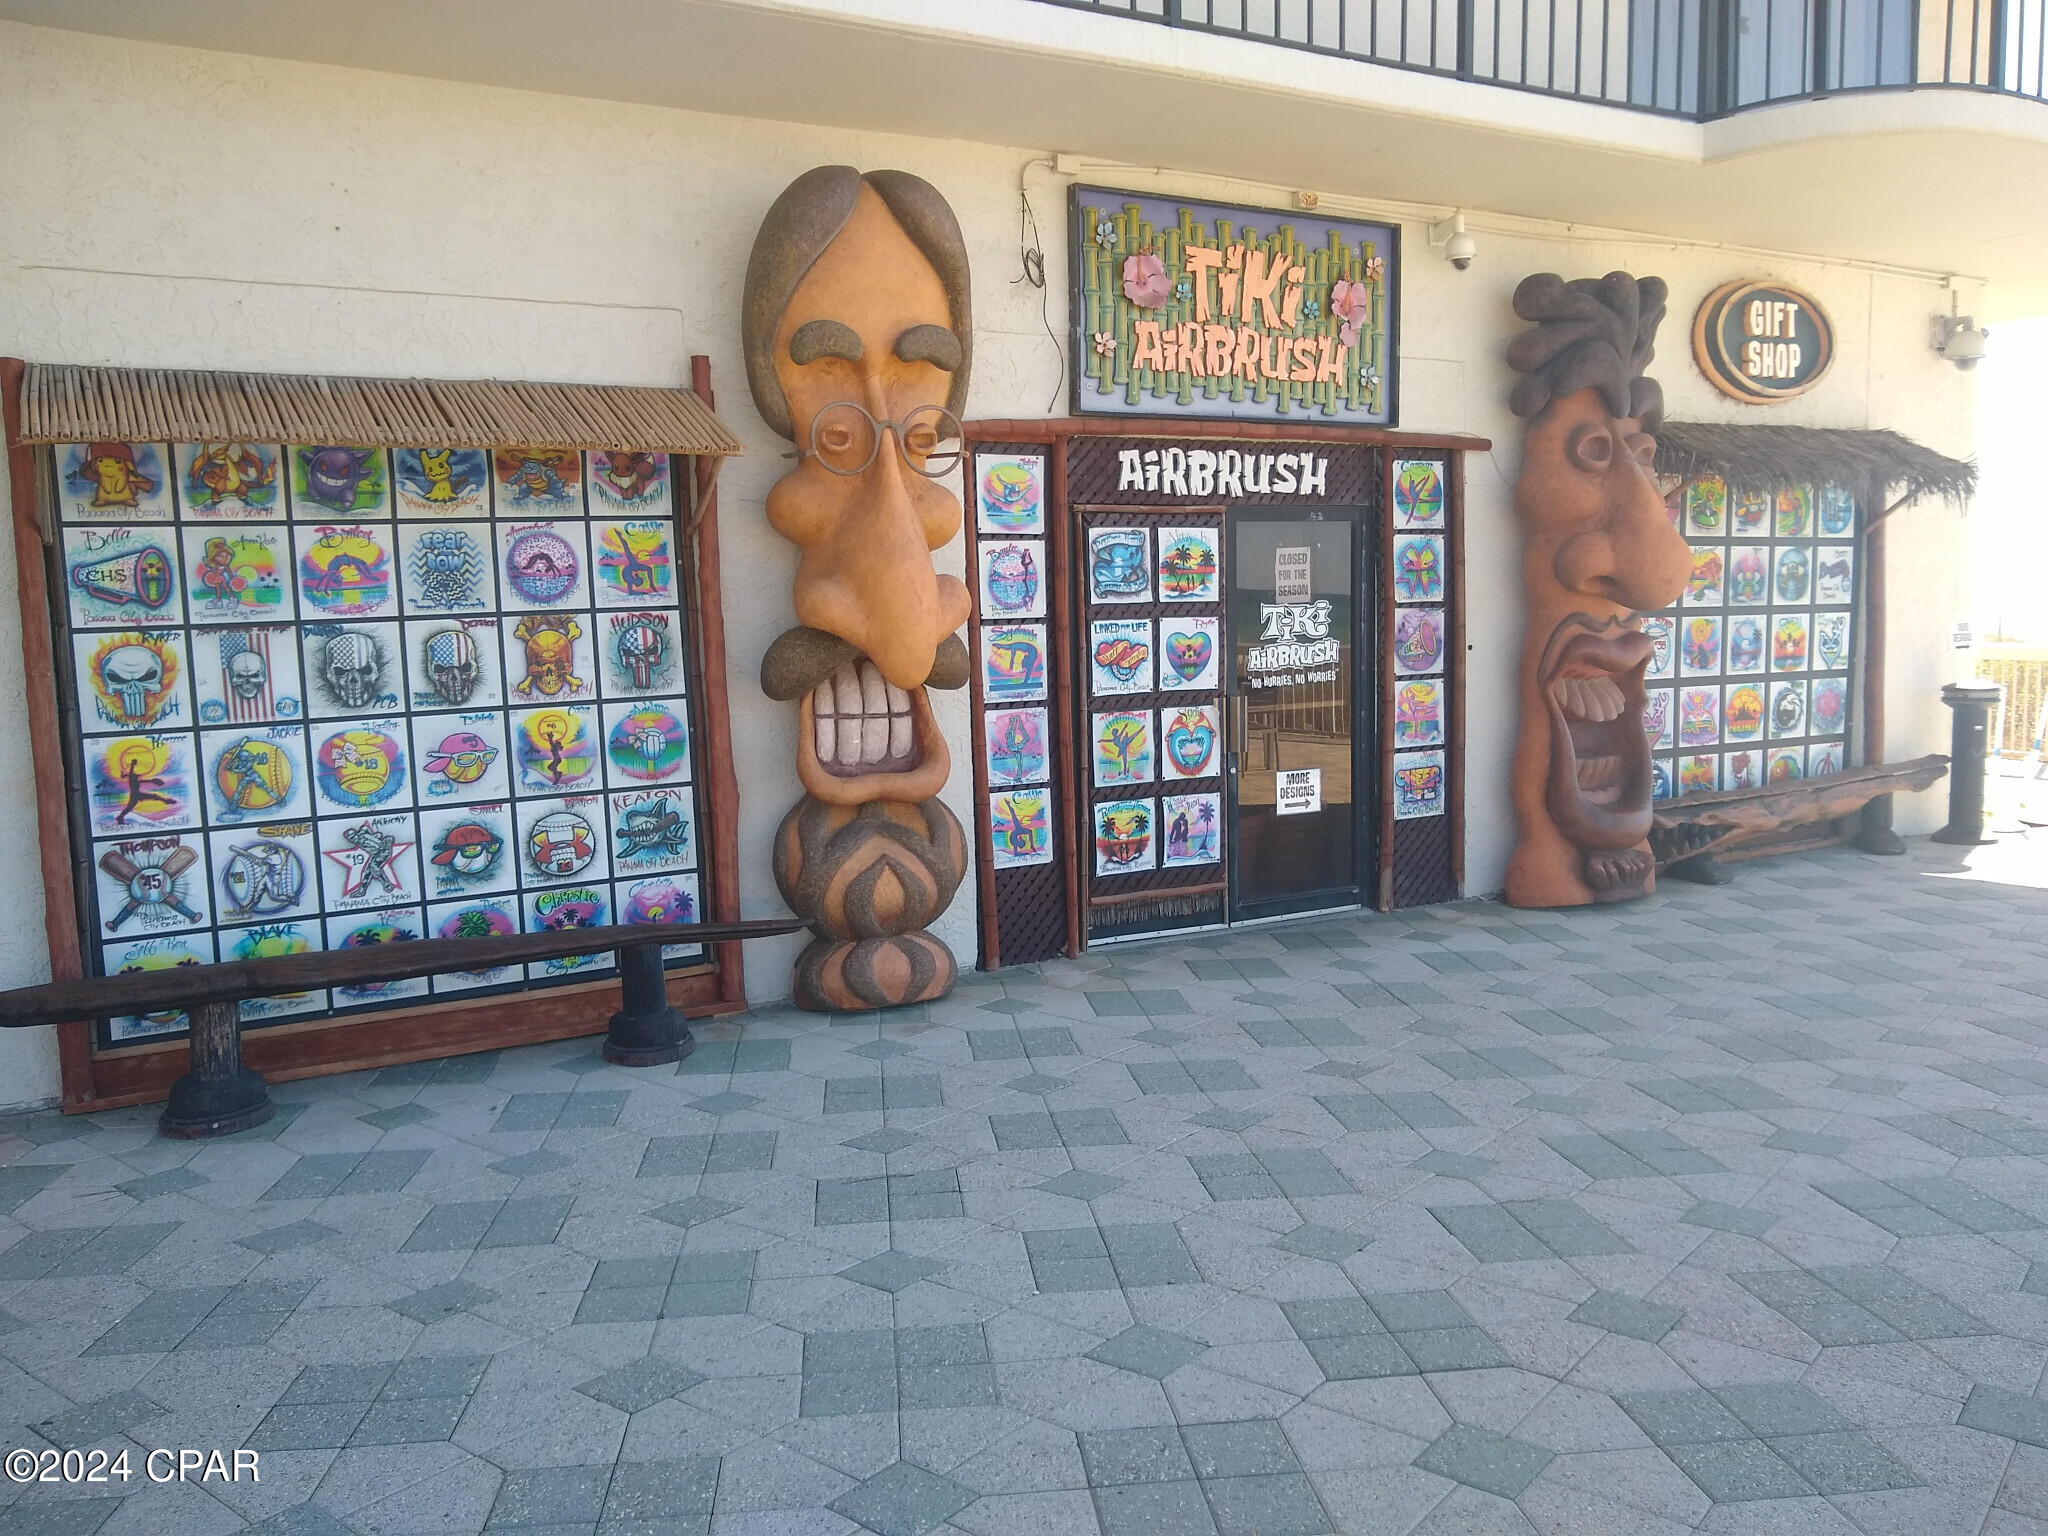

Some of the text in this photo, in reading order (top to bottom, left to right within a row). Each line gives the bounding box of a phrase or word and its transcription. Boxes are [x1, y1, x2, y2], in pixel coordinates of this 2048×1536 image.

[1746, 300, 1798, 338] GIFT
[1745, 340, 1801, 378] SHOP
[1278, 553, 1308, 565] CLOSED
[85, 568, 127, 583] CHS
[1279, 569, 1307, 580] FOR THE
[1278, 584, 1308, 597] SEASON
[1094, 622, 1120, 634] LINKED
[1131, 621, 1148, 633] LIFE
[1295, 673, 1305, 684] NO
[267, 726, 302, 739] JACKIE
[1286, 772, 1310, 786] MORE
[1280, 785, 1315, 799] DESIGNS
[612, 789, 682, 814] KEATON
[257, 822, 314, 839] SHANE
[112, 833, 181, 856] THOMPSON
[660, 854, 689, 869] BEACH
[242, 923, 300, 945] BLAKE
